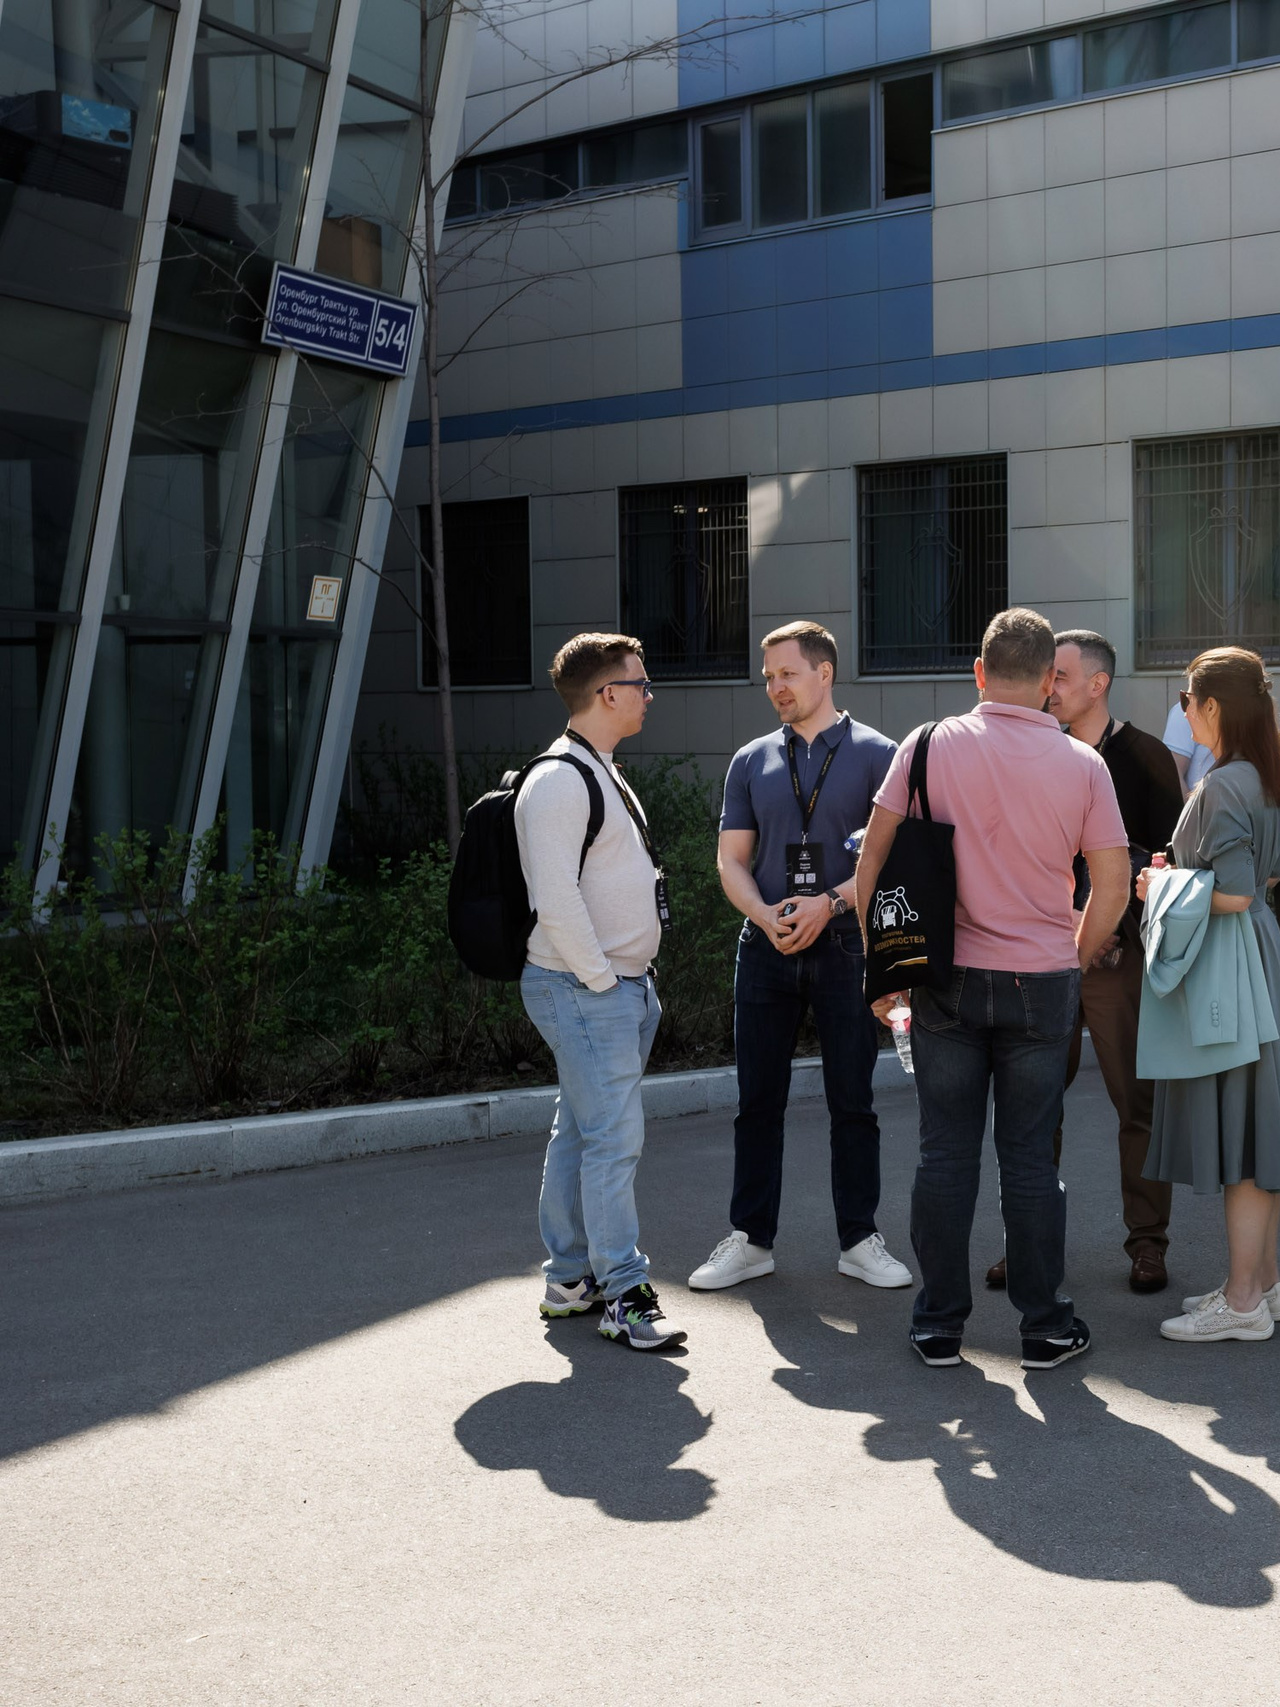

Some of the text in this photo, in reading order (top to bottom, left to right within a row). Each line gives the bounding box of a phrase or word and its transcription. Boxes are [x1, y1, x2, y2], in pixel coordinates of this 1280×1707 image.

[280, 284, 360, 316] Оренбург Тракты ур.
[275, 313, 361, 344] Orenburgskiy Trakt Str.
[276, 300, 369, 333] ул. Оренбургский Тракт
[375, 318, 407, 352] 5/4
